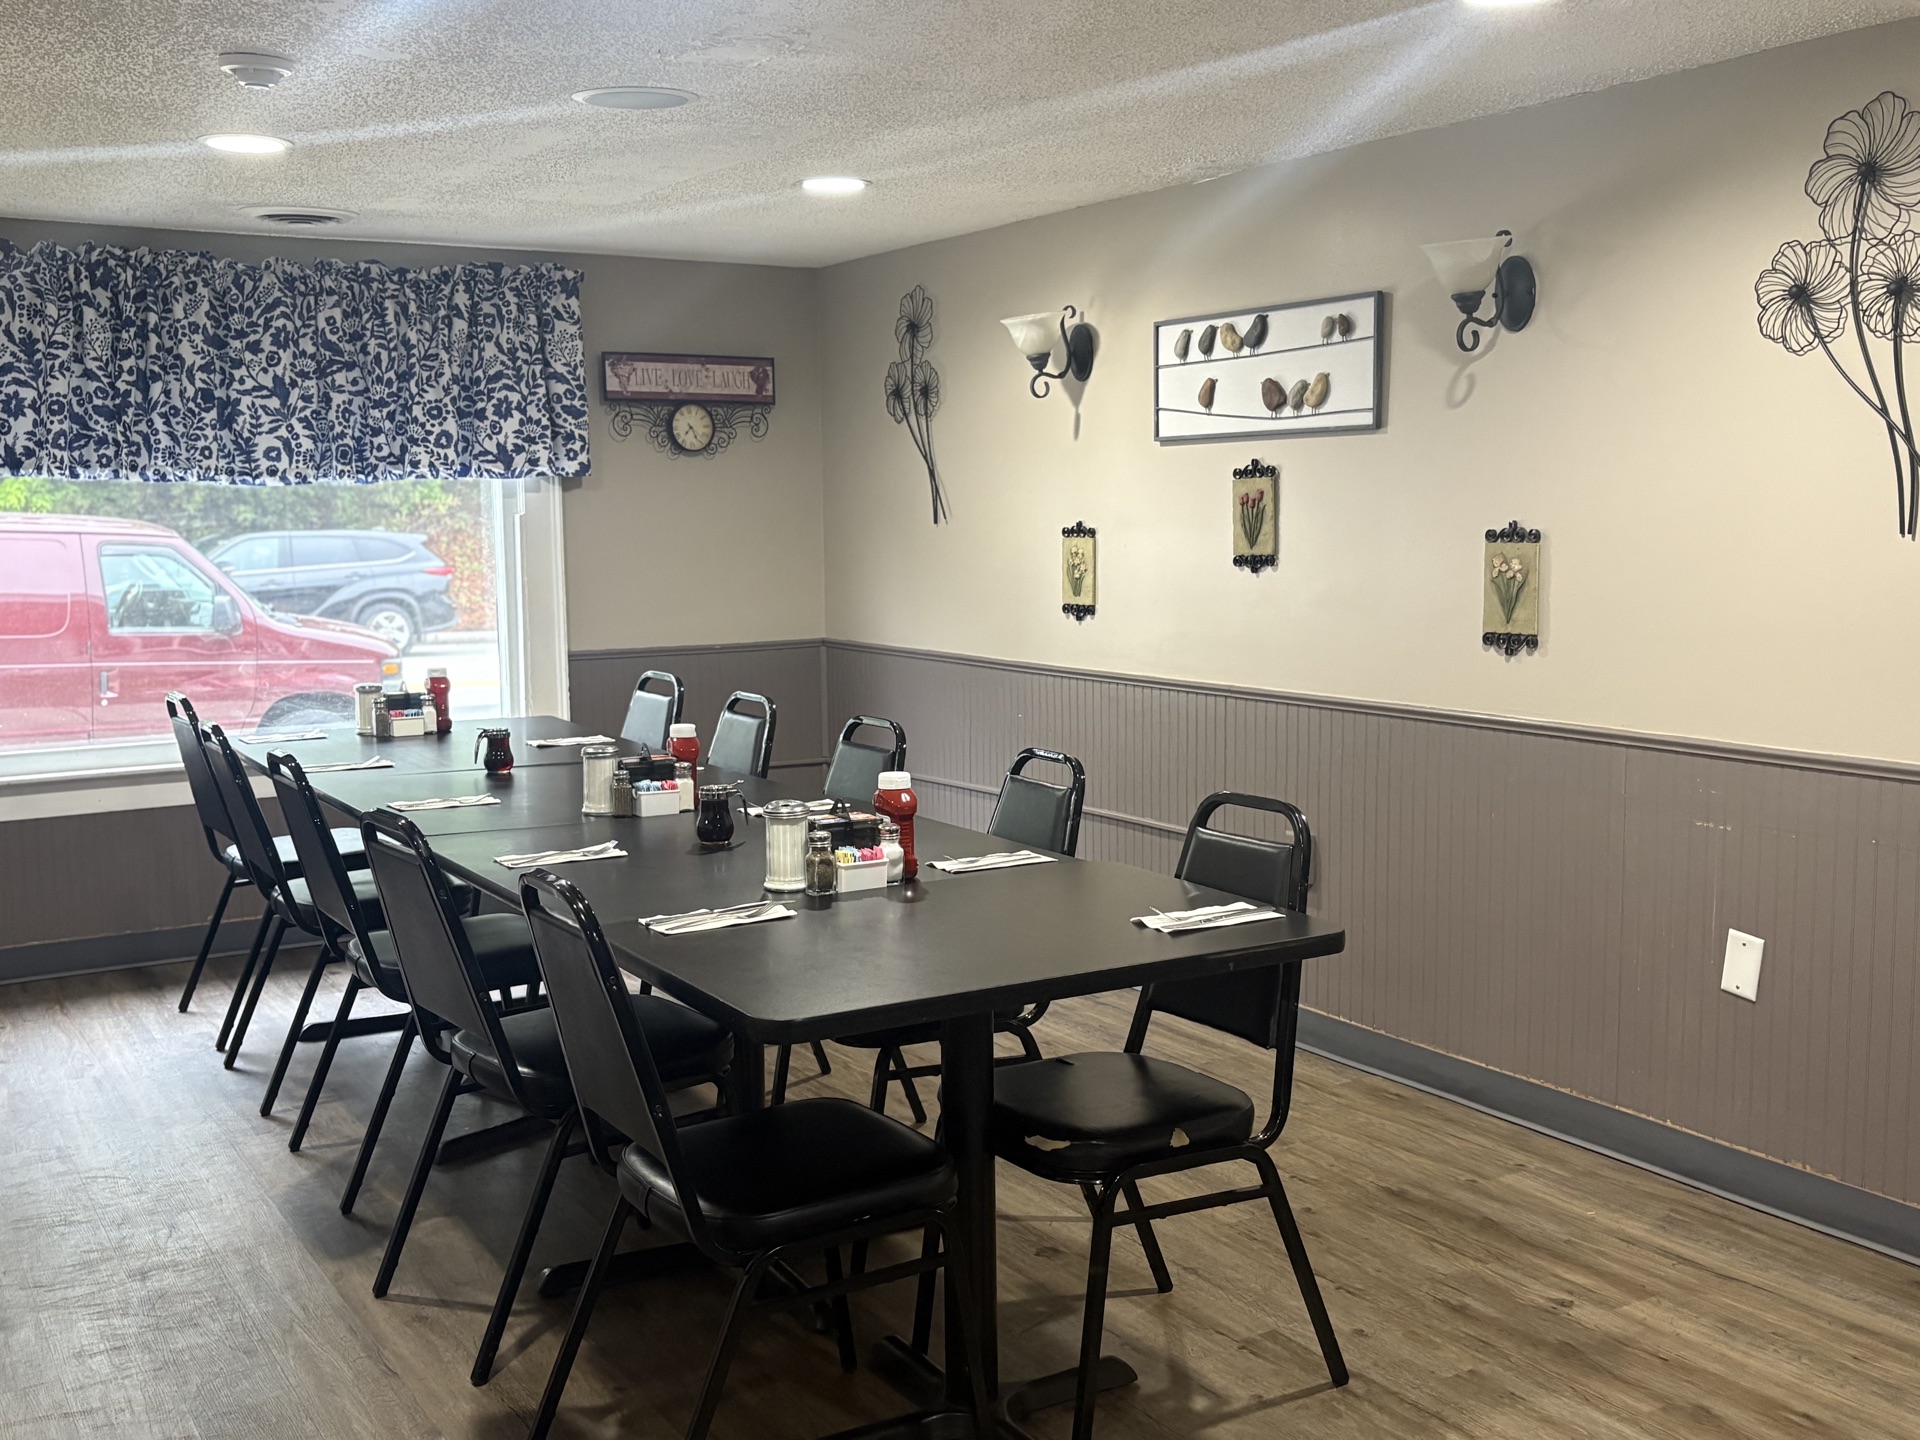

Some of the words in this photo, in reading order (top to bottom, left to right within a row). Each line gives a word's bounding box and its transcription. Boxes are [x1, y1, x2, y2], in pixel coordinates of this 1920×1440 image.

[634, 367, 662, 386] LIVE
[672, 369, 702, 387] LOVE
[712, 370, 751, 389] LAUGH
